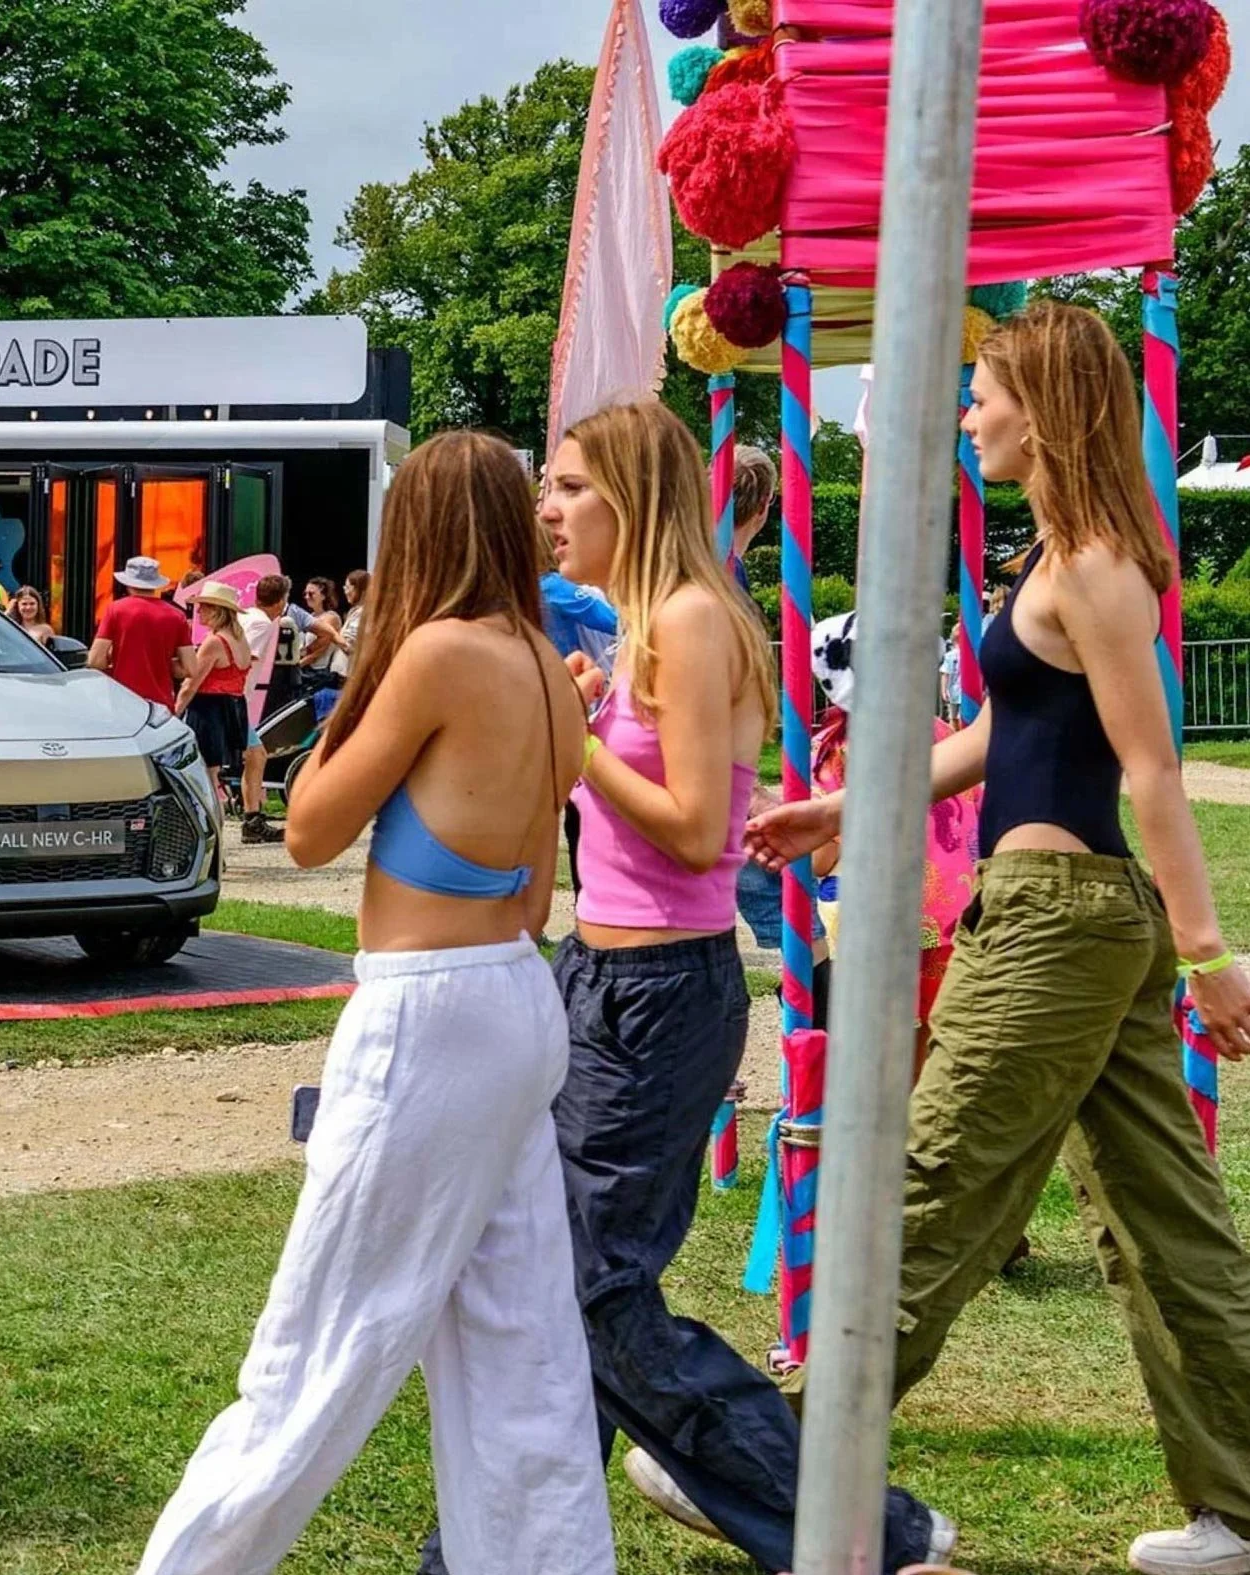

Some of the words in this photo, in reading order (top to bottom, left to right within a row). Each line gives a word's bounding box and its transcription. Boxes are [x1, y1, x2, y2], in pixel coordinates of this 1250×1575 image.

[0, 833, 28, 848] ALL
[32, 832, 69, 847] NEW
[73, 830, 113, 846] C-HR
